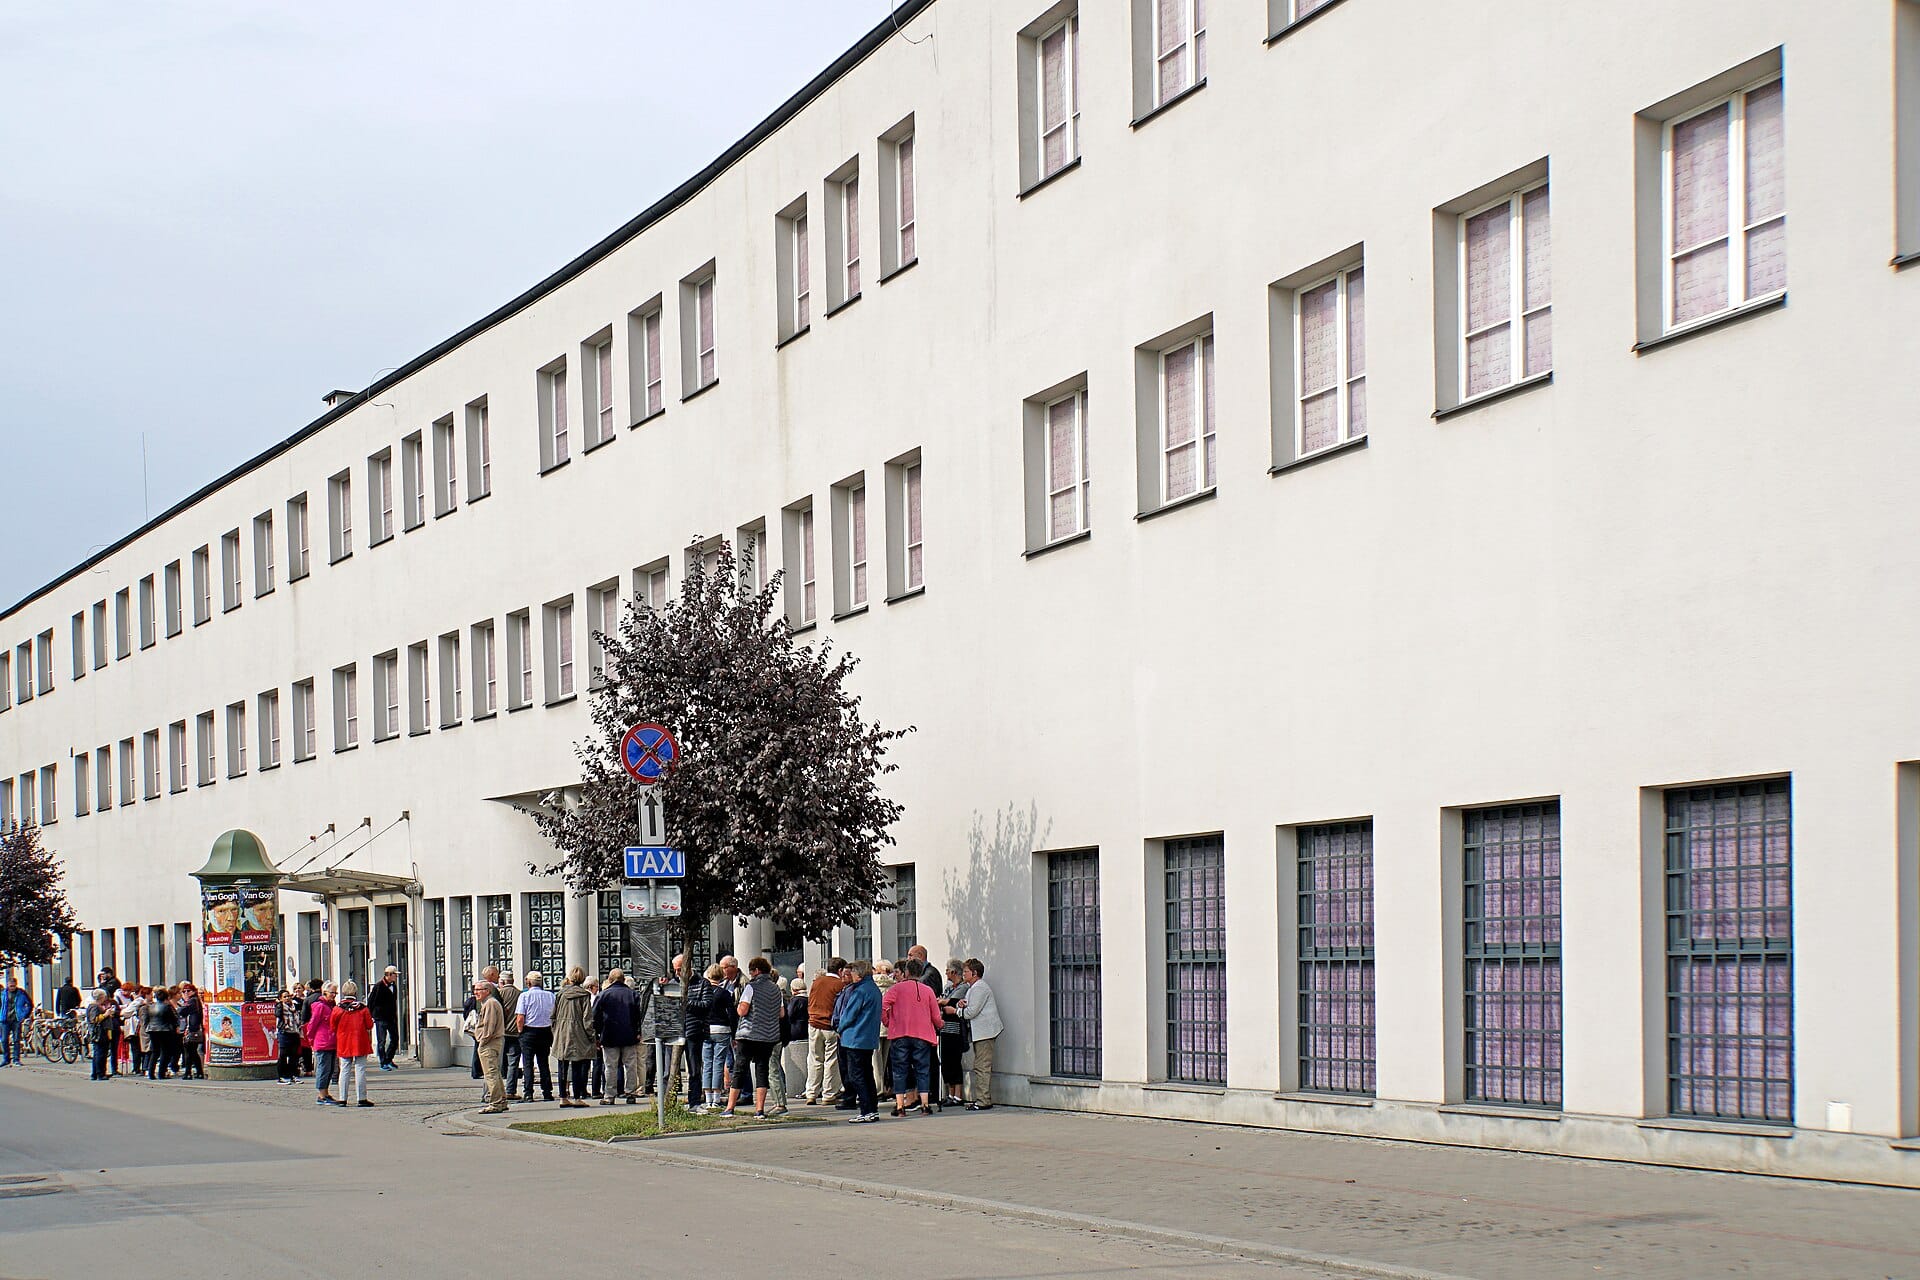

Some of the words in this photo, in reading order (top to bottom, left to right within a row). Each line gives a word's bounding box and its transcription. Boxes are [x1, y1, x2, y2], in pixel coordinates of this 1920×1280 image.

[628, 851, 682, 873] TAXI
[218, 893, 238, 901] Gogh
[258, 891, 274, 900] Gogh
